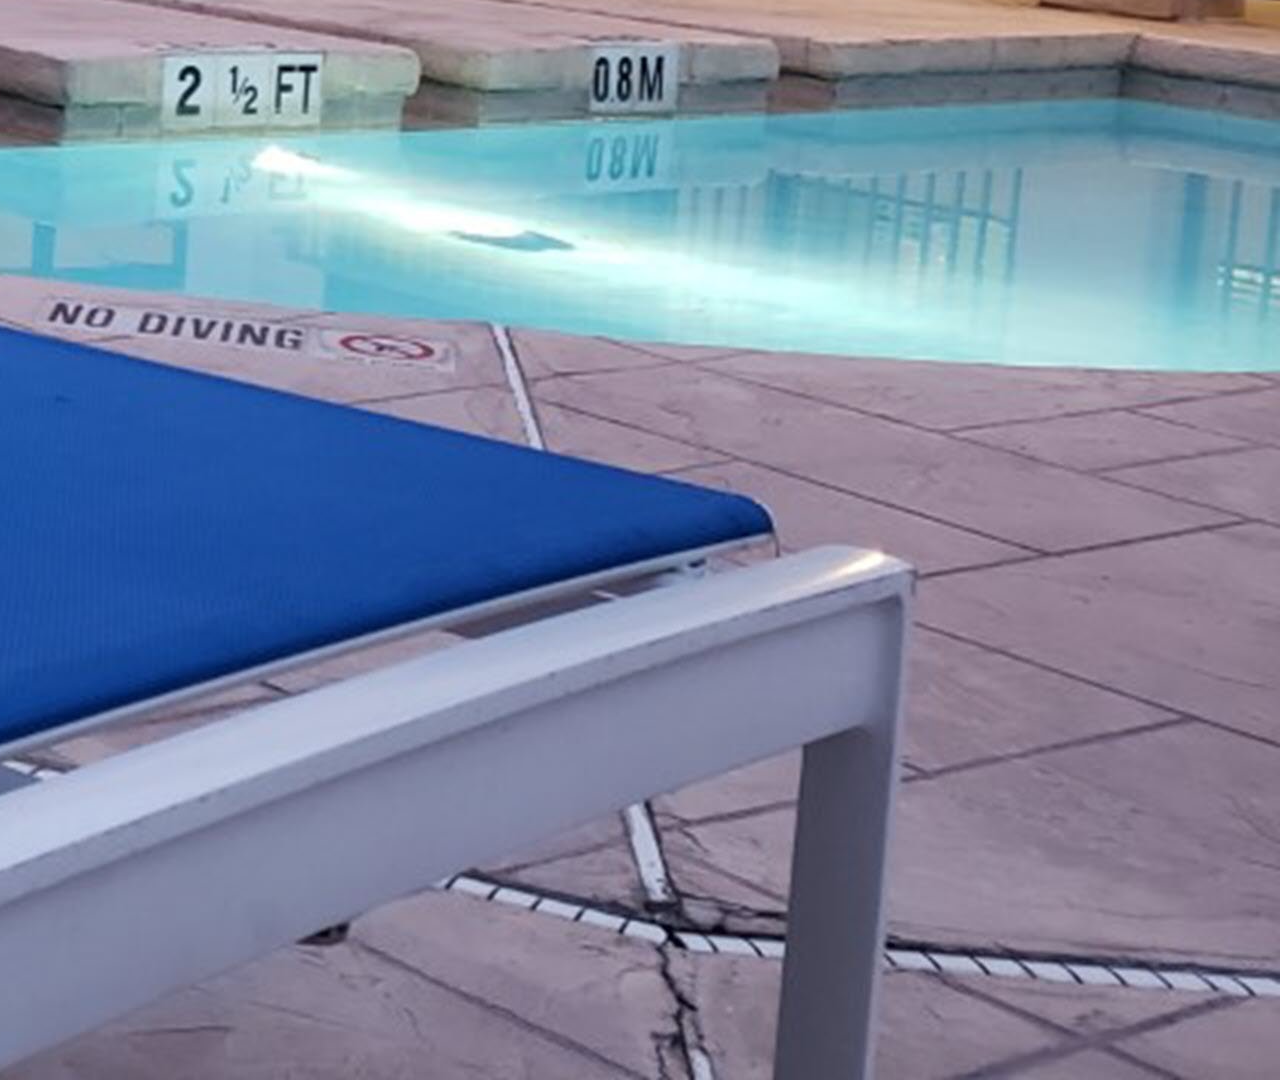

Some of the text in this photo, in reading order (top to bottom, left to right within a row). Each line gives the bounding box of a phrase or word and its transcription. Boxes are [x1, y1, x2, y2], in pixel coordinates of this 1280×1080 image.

[175, 64, 203, 117] 2
[273, 64, 320, 116] FT
[48, 301, 305, 352] NO DIVING
